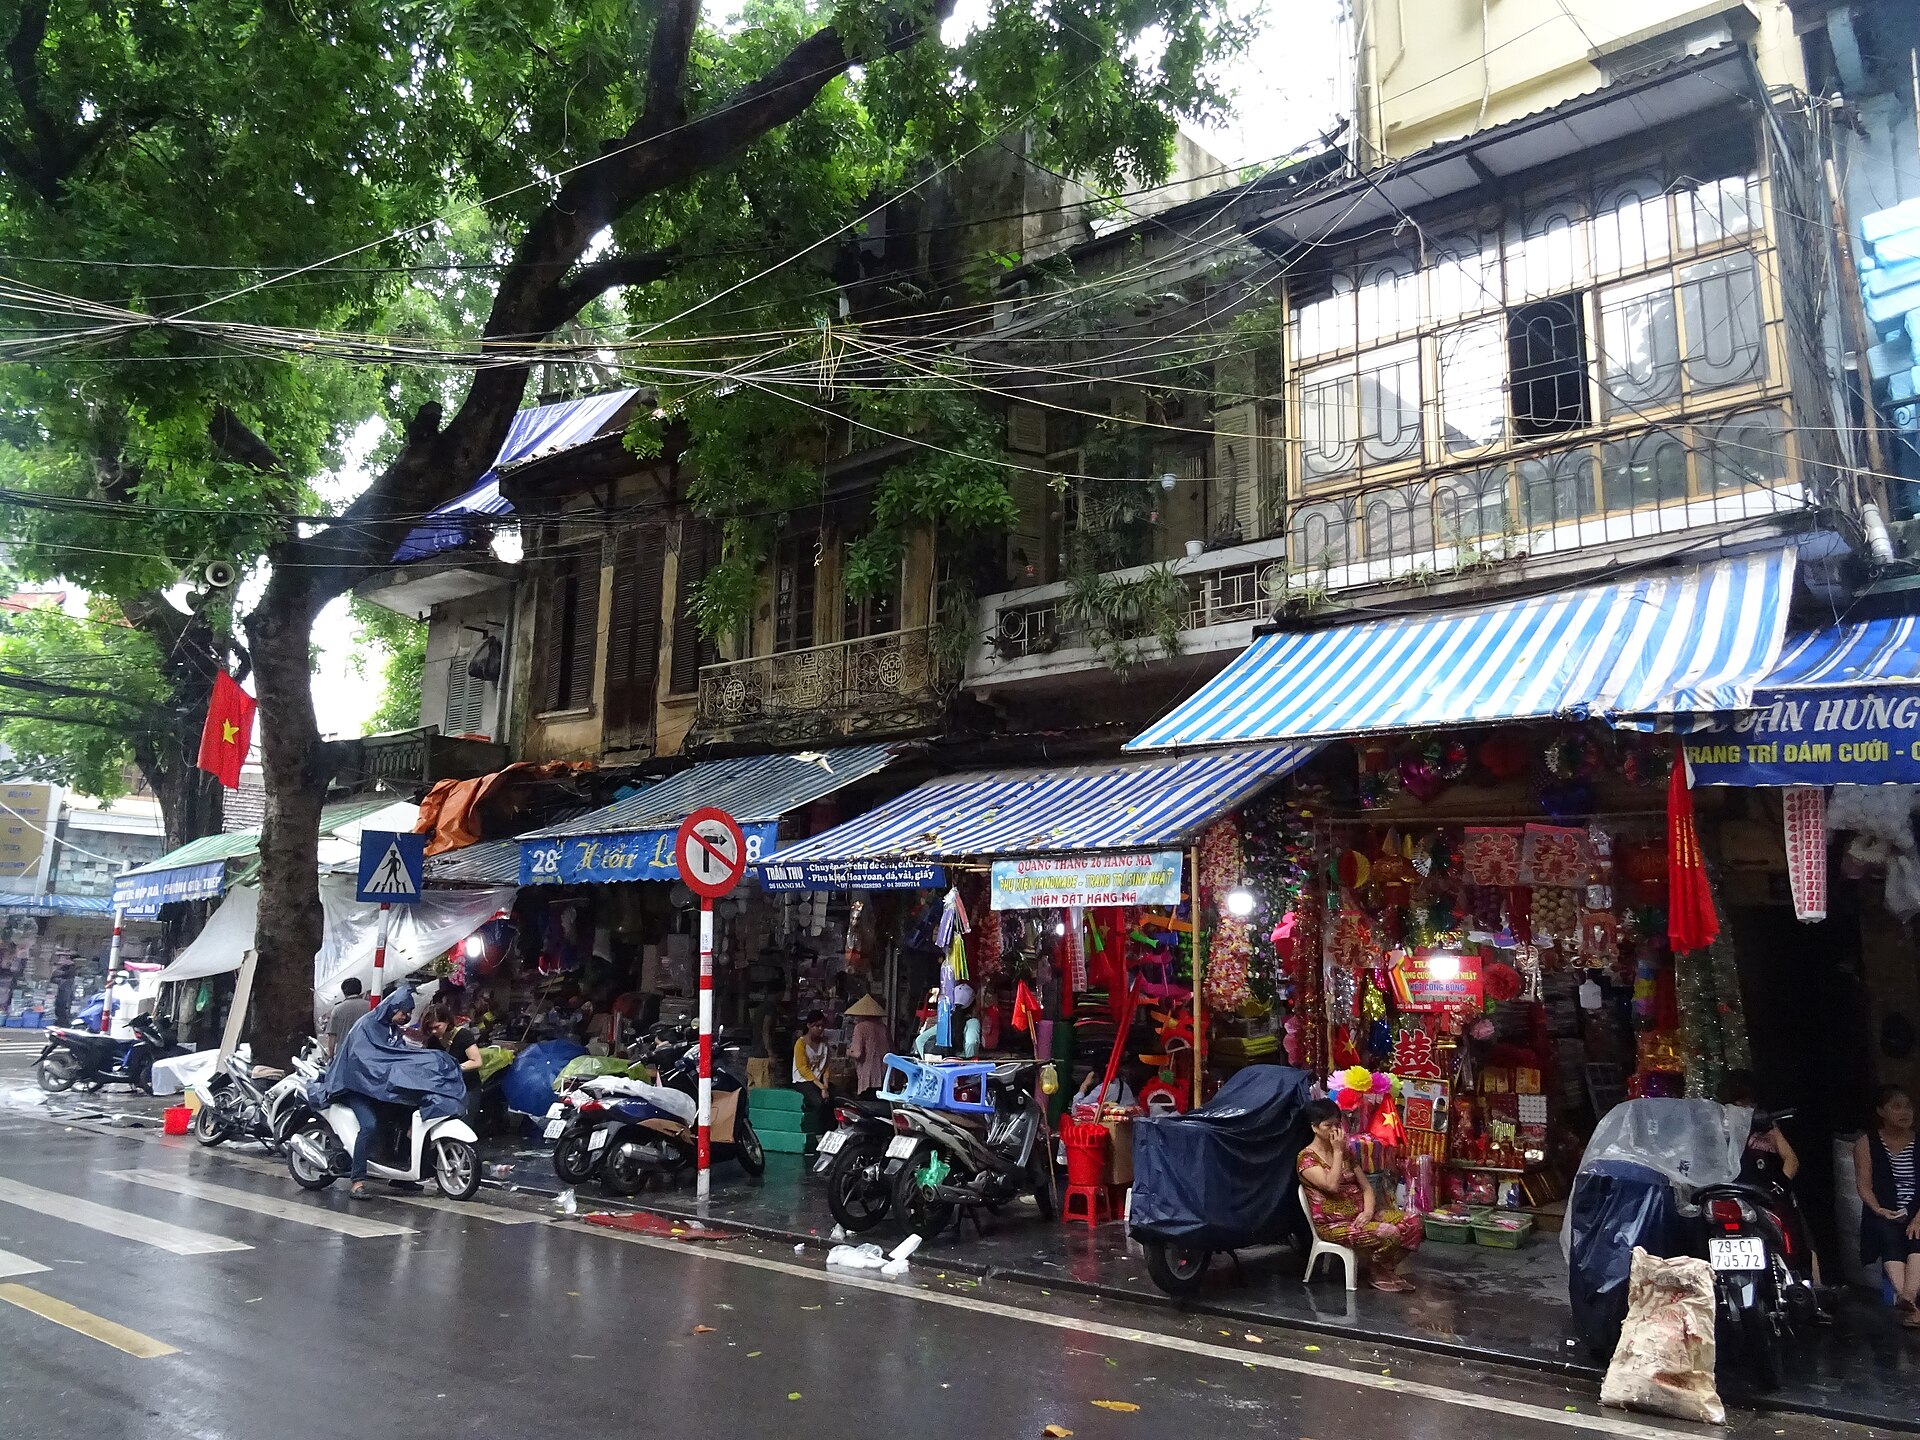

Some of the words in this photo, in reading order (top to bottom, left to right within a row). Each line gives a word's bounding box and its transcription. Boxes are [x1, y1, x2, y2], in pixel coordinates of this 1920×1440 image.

[1813, 693, 1920, 731] HƯNG
[1746, 741, 1778, 763] TRÍ
[1784, 740, 1831, 763] ĐÁM
[1838, 739, 1889, 762] CƯỚI
[531, 849, 558, 873] 28
[1091, 856, 1102, 868] 26
[1031, 892, 1059, 907] NHẬN
[1717, 1240, 1753, 1253] 29-C1
[1715, 1254, 1761, 1268] 705.72
